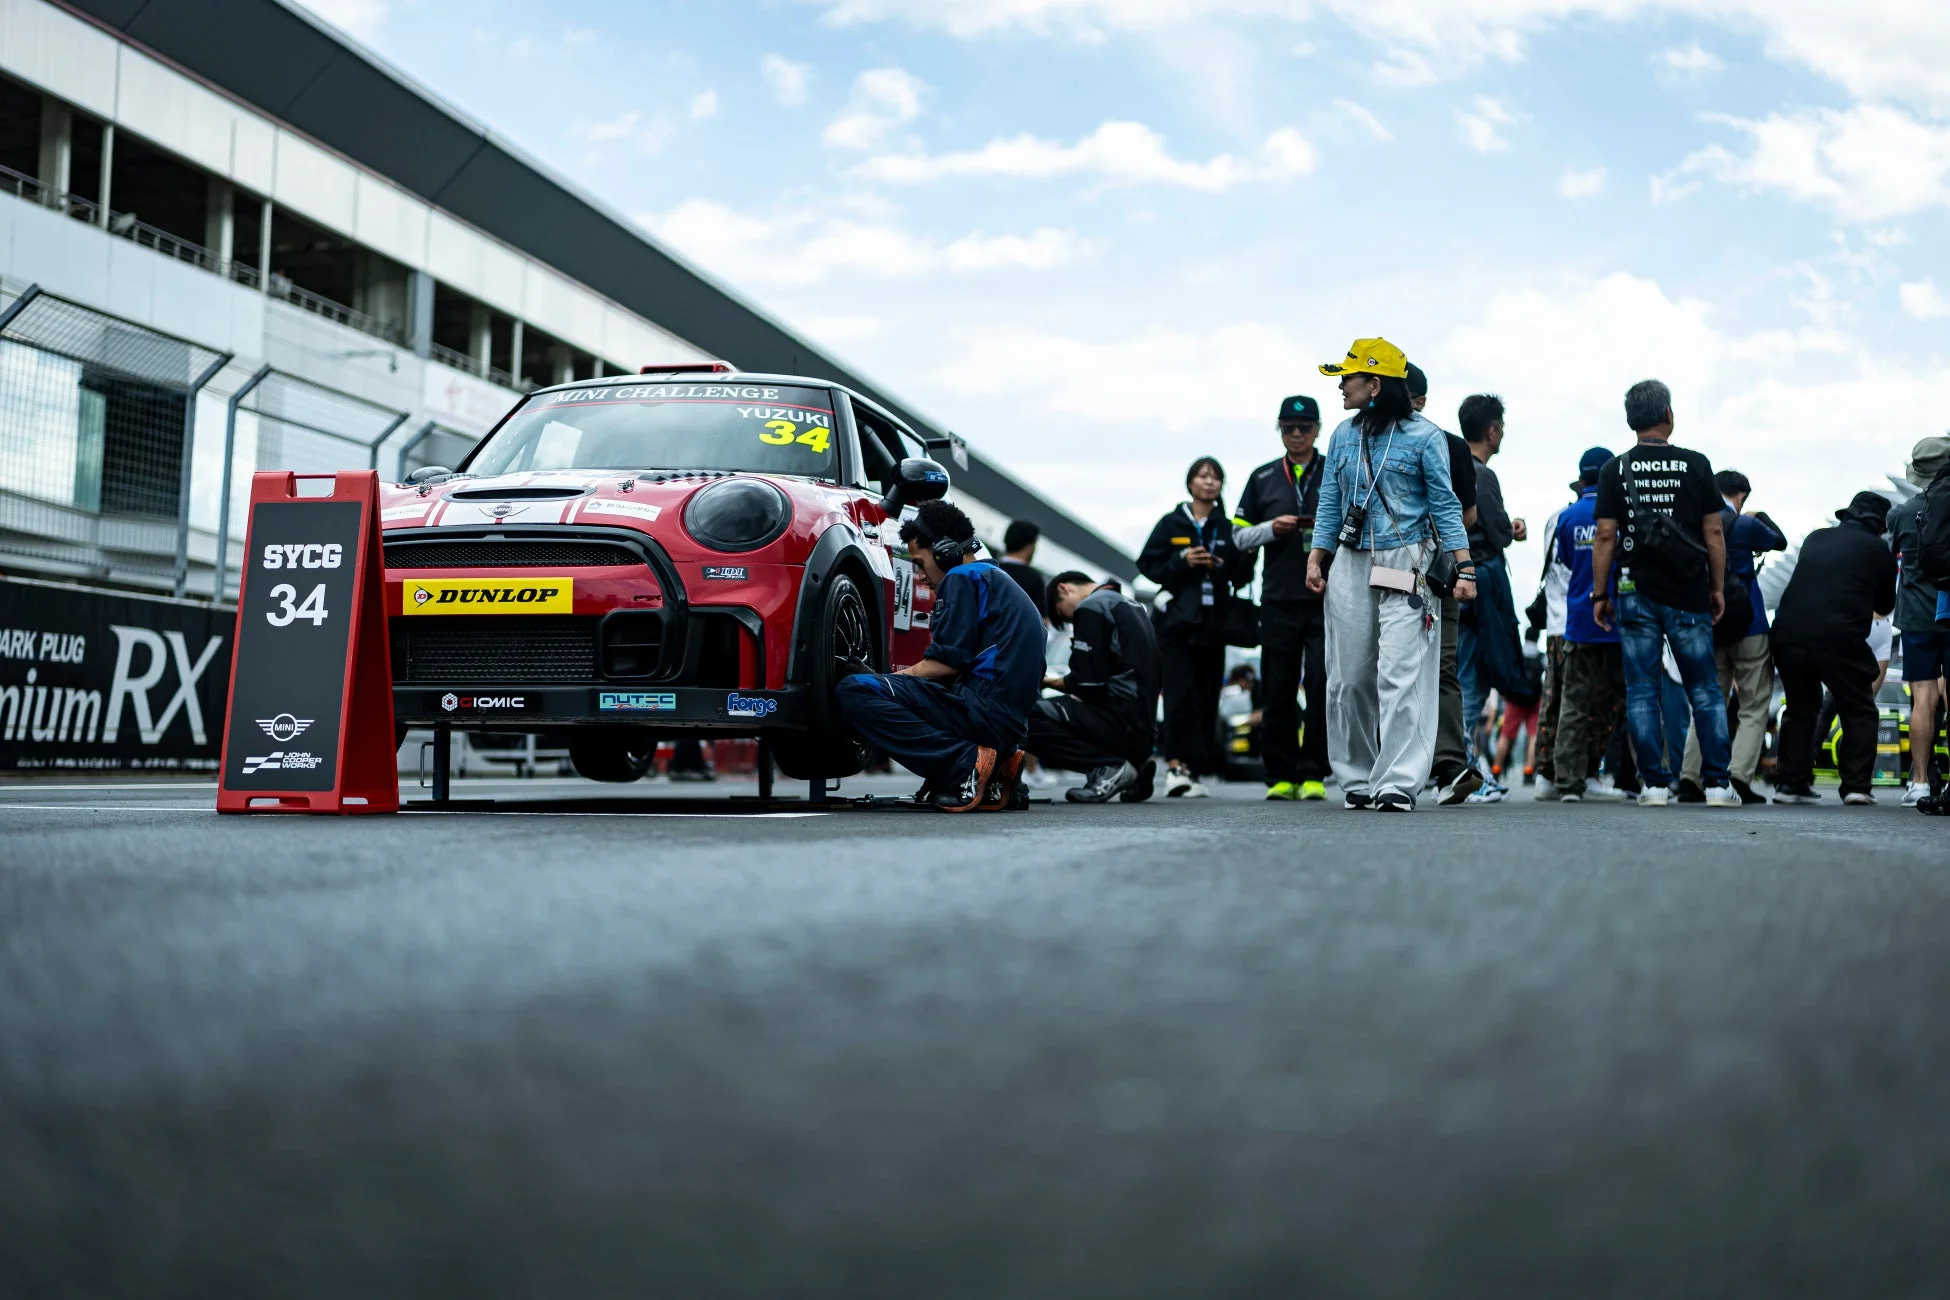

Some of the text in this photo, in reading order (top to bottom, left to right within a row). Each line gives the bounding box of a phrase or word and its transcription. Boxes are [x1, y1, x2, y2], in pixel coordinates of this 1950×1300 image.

[551, 385, 779, 403] MINI CHALLENGE
[736, 407, 829, 428] YUZUKI
[758, 420, 831, 453] 34
[1619, 460, 1688, 475] ONCLER
[1634, 479, 1651, 488] THE
[1651, 479, 1681, 488] SOUTH
[1652, 493, 1676, 503] WEST
[263, 543, 343, 569] SYCG
[266, 583, 329, 627] 34
[436, 588, 559, 604] DUNLOP
[0, 628, 86, 664] ARK PLUG
[102, 624, 224, 746] RX
[460, 697, 525, 708] GIOMIC
[602, 694, 674, 704] NUTEC
[727, 692, 777, 717] Forge
[274, 723, 294, 732] MINI
